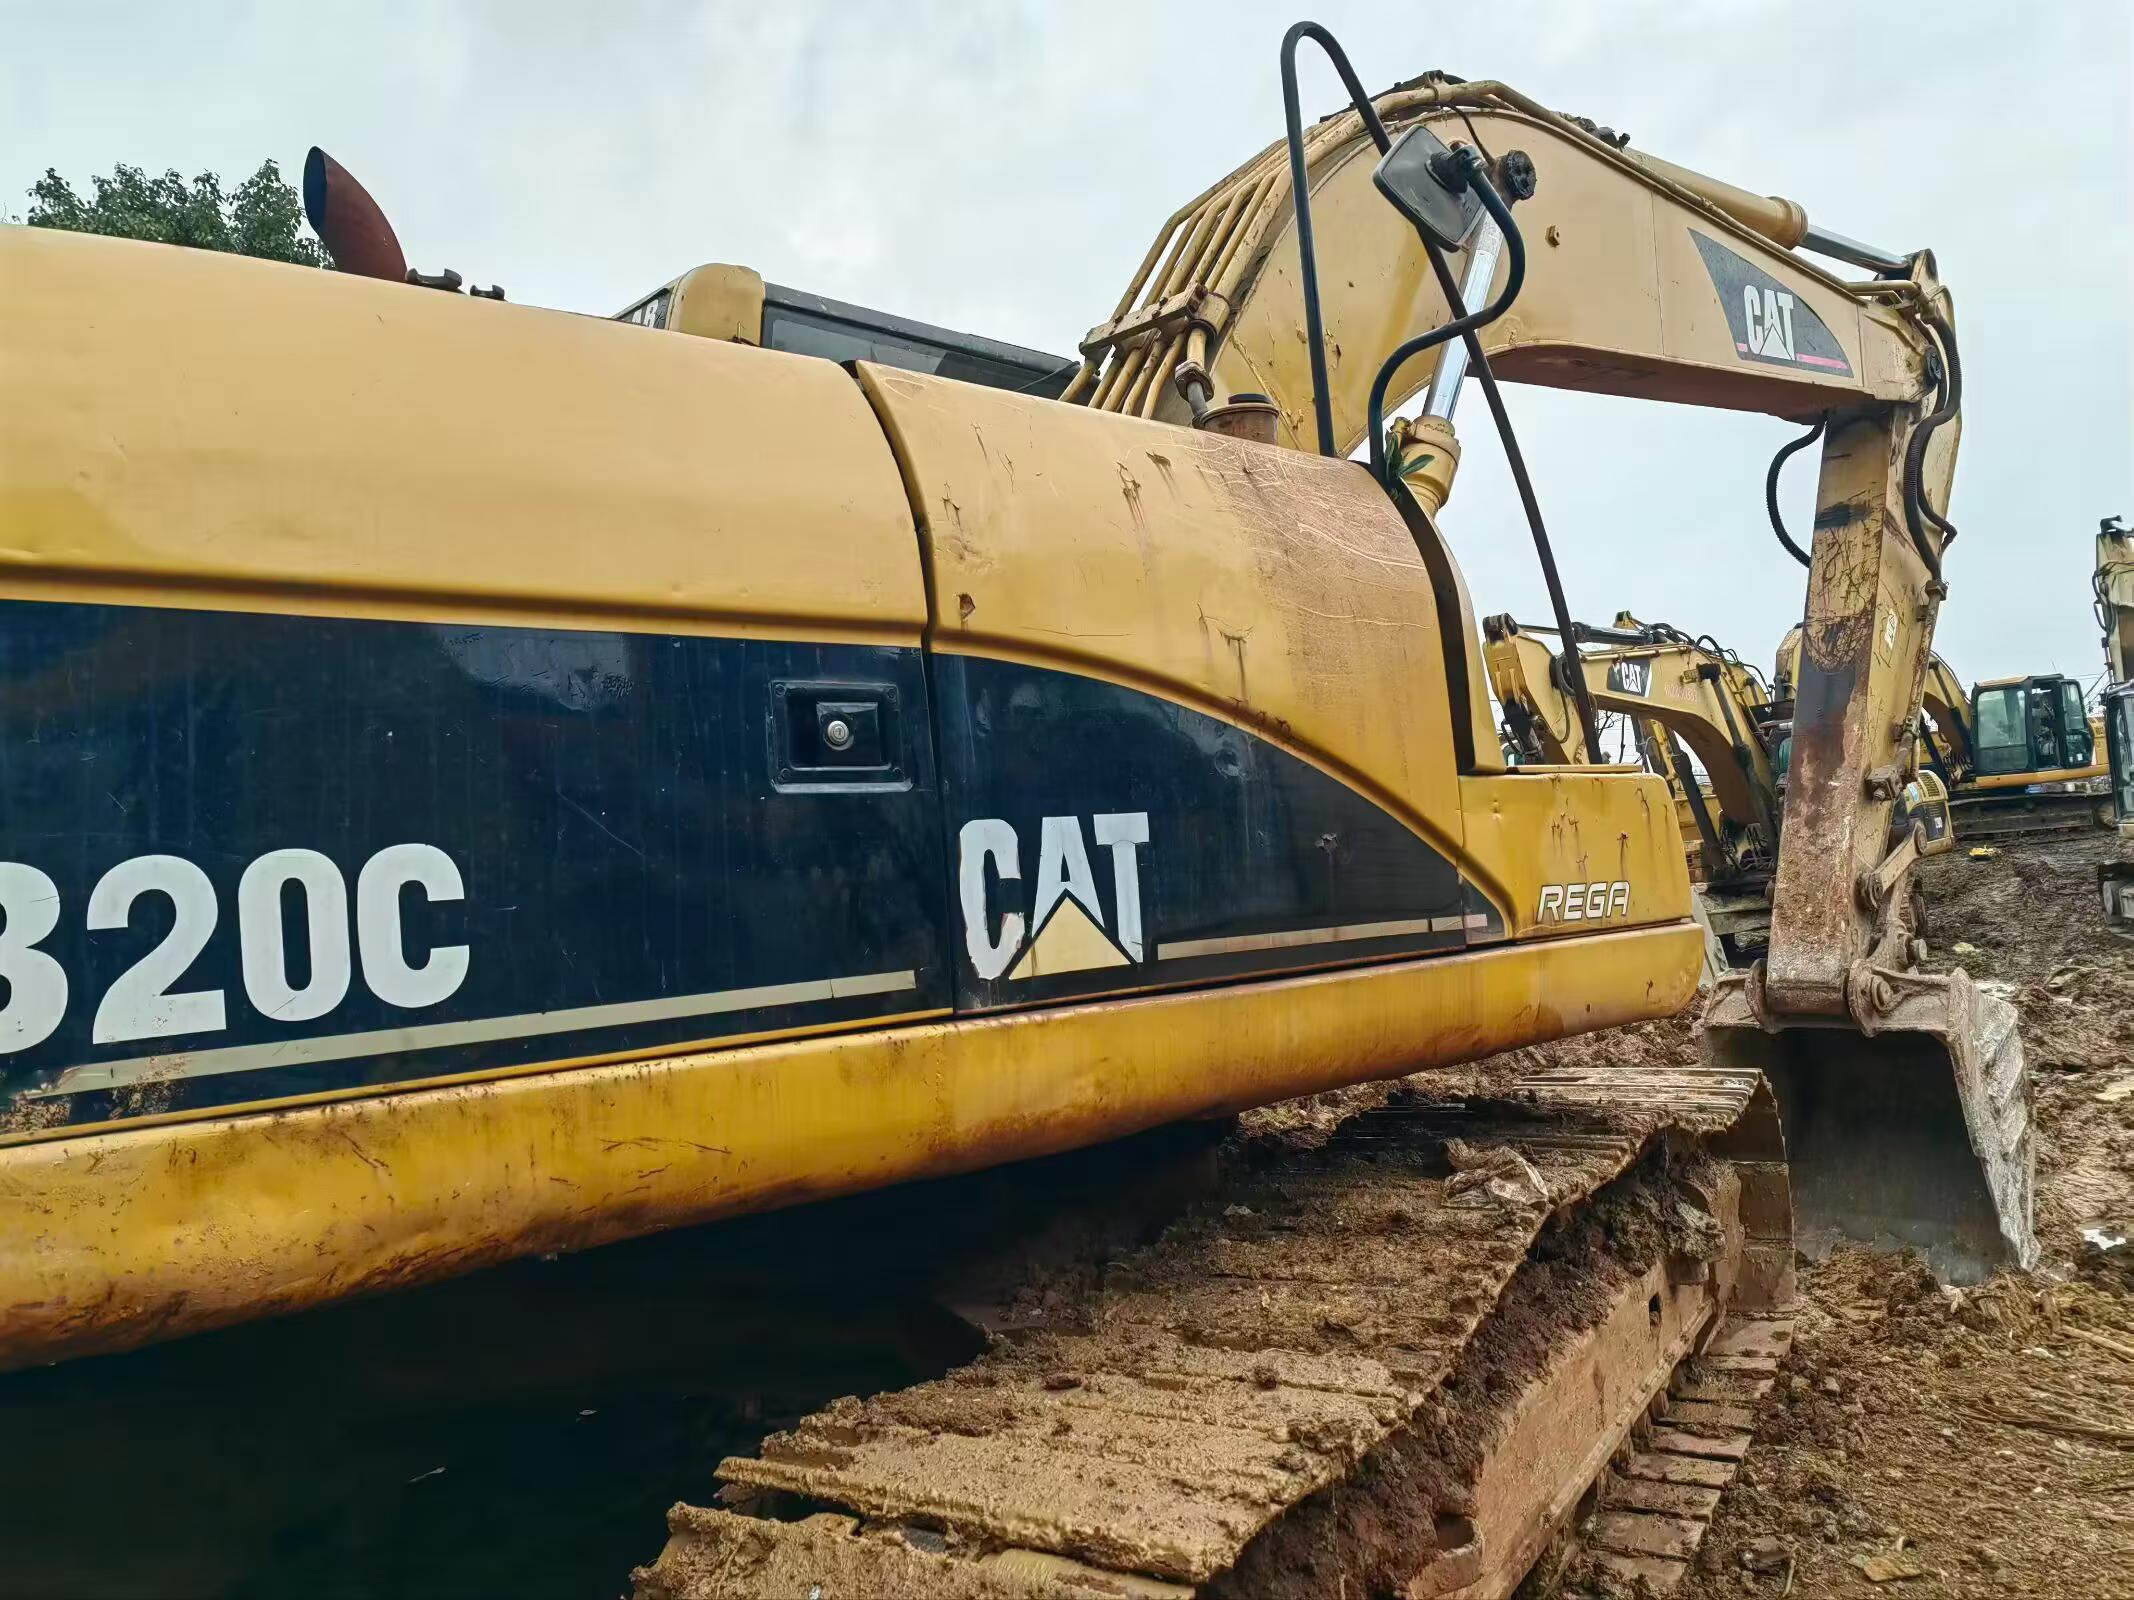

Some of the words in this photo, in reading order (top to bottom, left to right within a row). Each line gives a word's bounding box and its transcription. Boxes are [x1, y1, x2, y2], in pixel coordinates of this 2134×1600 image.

[1743, 284, 1796, 361] CAT
[1621, 661, 1642, 694] CAT
[959, 811, 1150, 980] CAT
[1536, 880, 1630, 922] REGA
